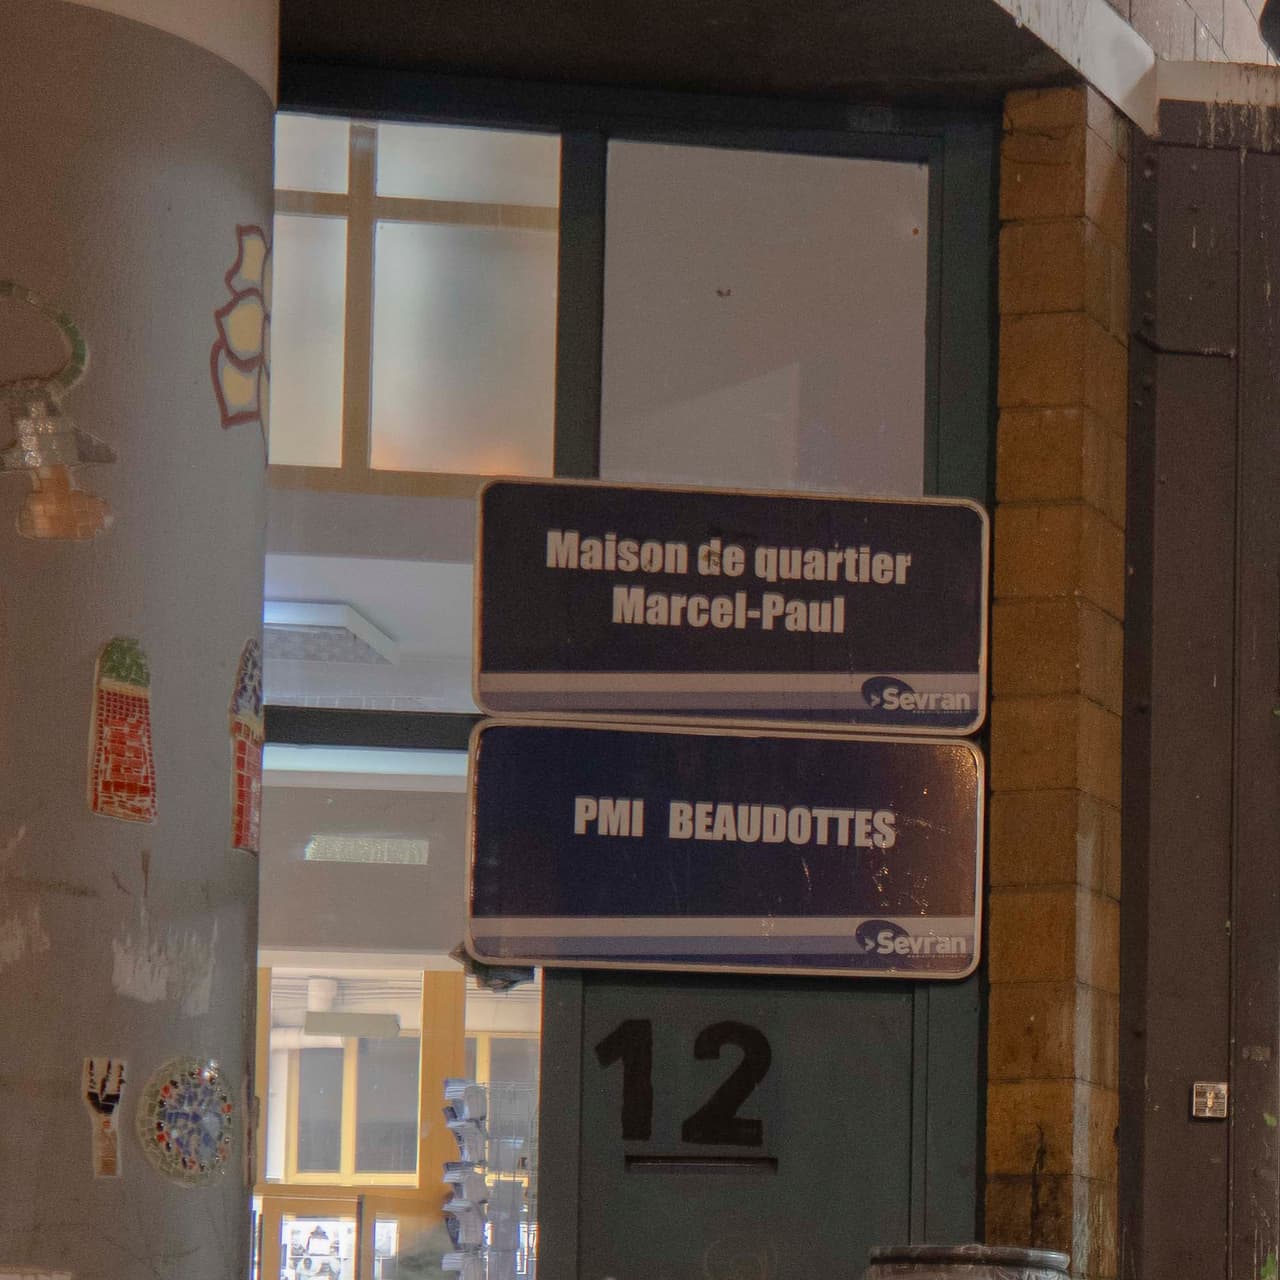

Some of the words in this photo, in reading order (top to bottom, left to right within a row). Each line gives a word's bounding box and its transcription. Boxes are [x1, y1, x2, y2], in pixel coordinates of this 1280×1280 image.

[546, 529, 689, 575] Maison
[697, 537, 745, 578] de
[754, 543, 912, 585] quartier
[612, 585, 845, 634] Marcel-Paul
[881, 687, 971, 711] Sevran
[573, 796, 644, 838] PMI
[668, 801, 897, 849] BEAUDOTTES
[876, 931, 967, 955] Sevran
[594, 1018, 772, 1147] 12
